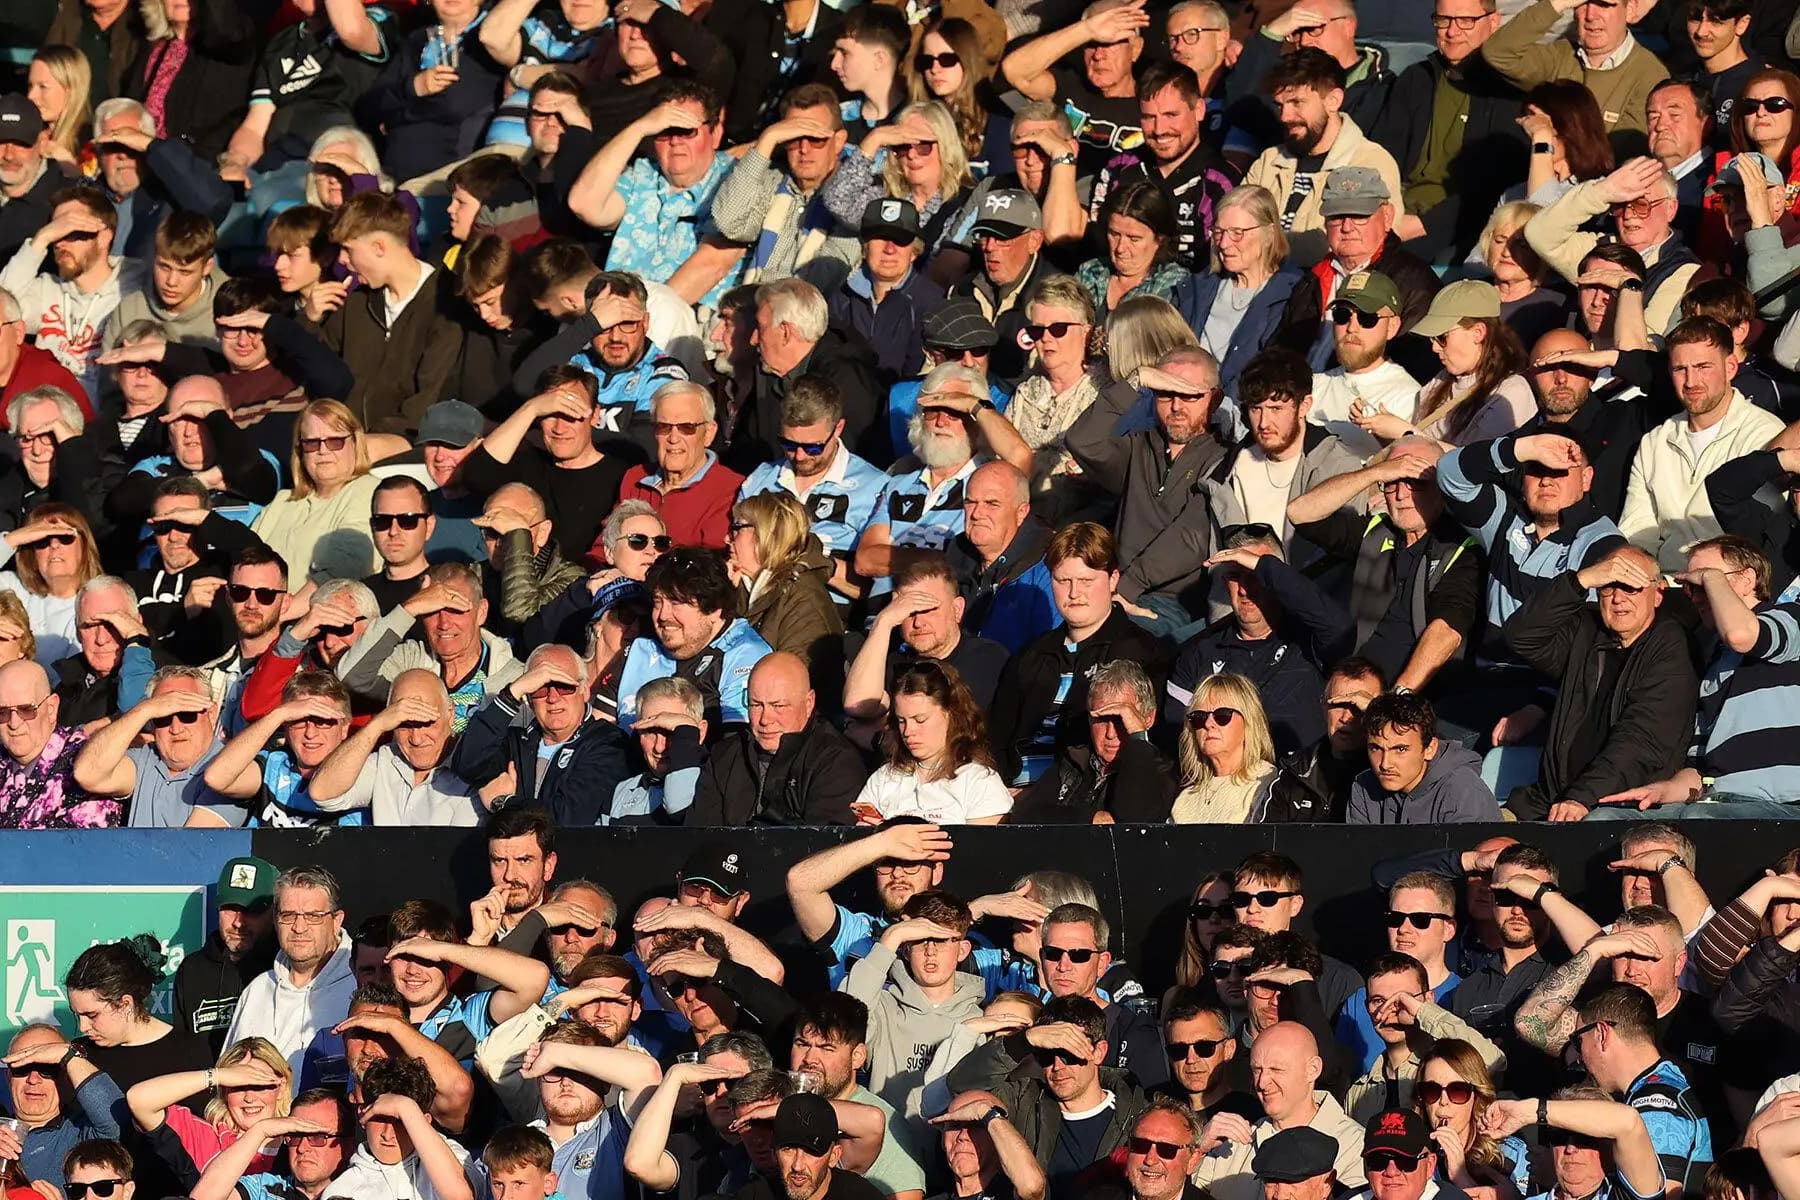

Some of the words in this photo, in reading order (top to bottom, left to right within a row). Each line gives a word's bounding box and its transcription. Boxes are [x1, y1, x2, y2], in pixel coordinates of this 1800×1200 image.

[913, 1043, 936, 1057] USU
[906, 1056, 931, 1071] SUSP
[1649, 1095, 1677, 1107] MOTIVE
